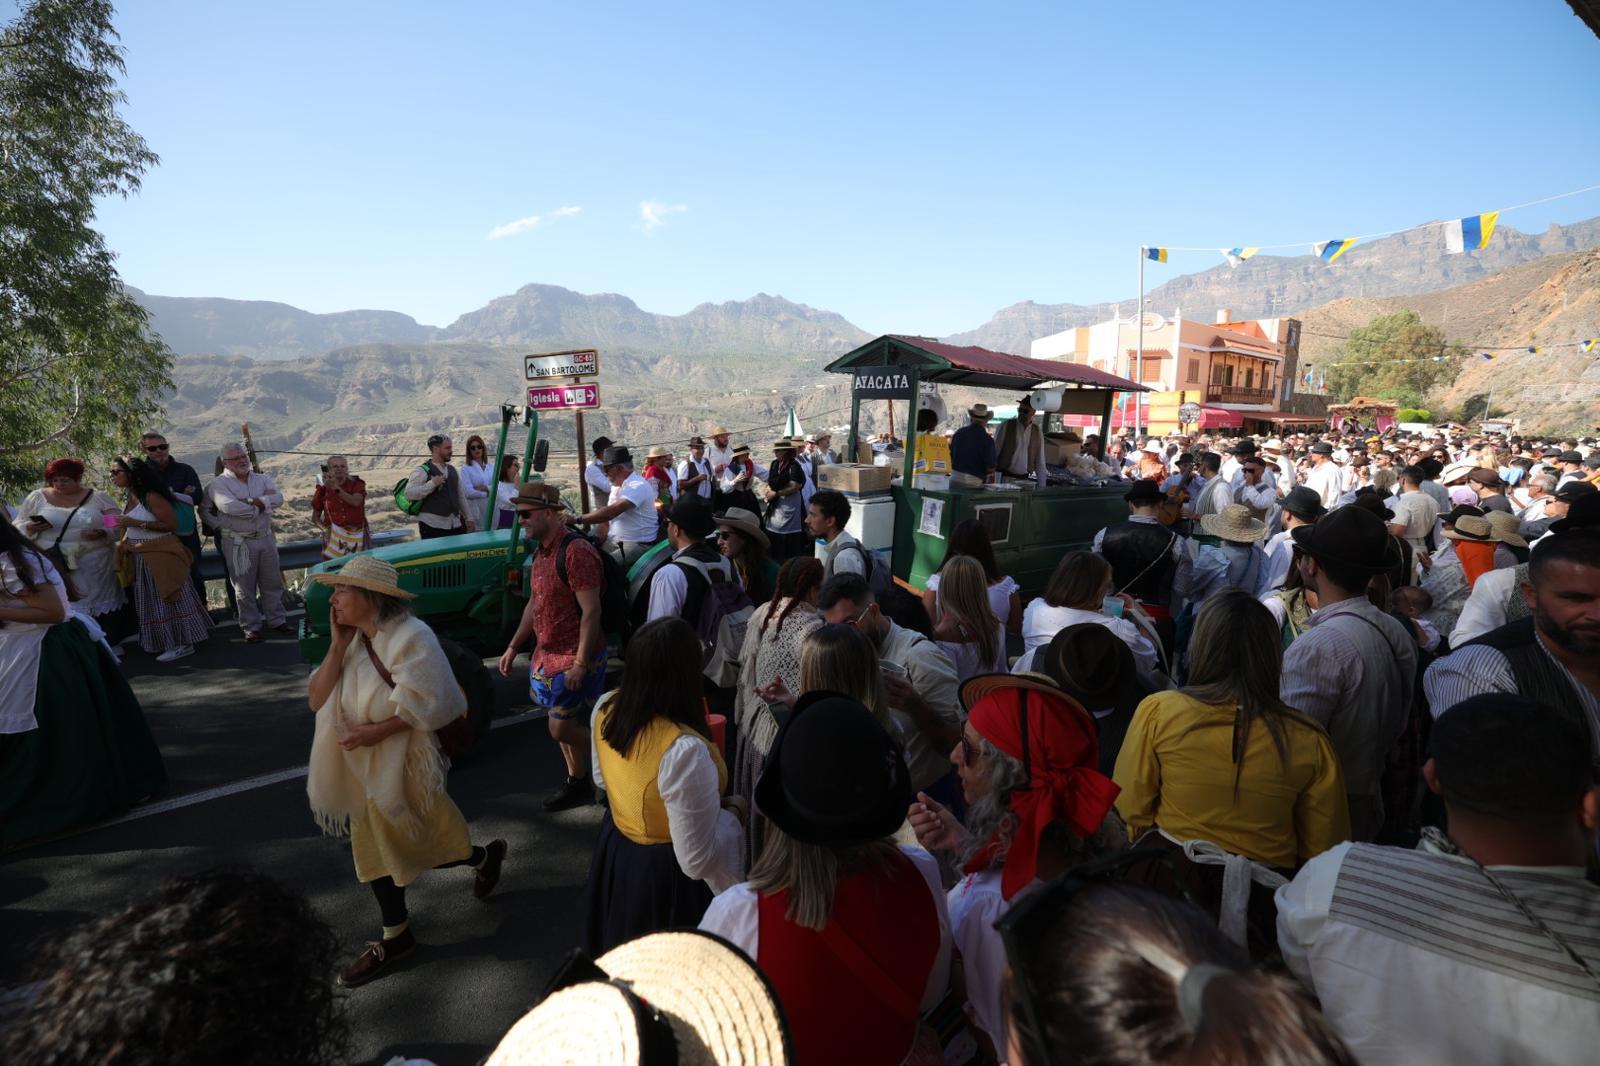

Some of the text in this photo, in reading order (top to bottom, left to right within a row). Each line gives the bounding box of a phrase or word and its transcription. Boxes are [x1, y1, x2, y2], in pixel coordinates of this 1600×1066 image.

[536, 367, 550, 377] SAN
[855, 374, 909, 389] AYACATA
[530, 391, 560, 405] Iglesia
[467, 551, 489, 560] JOHN
